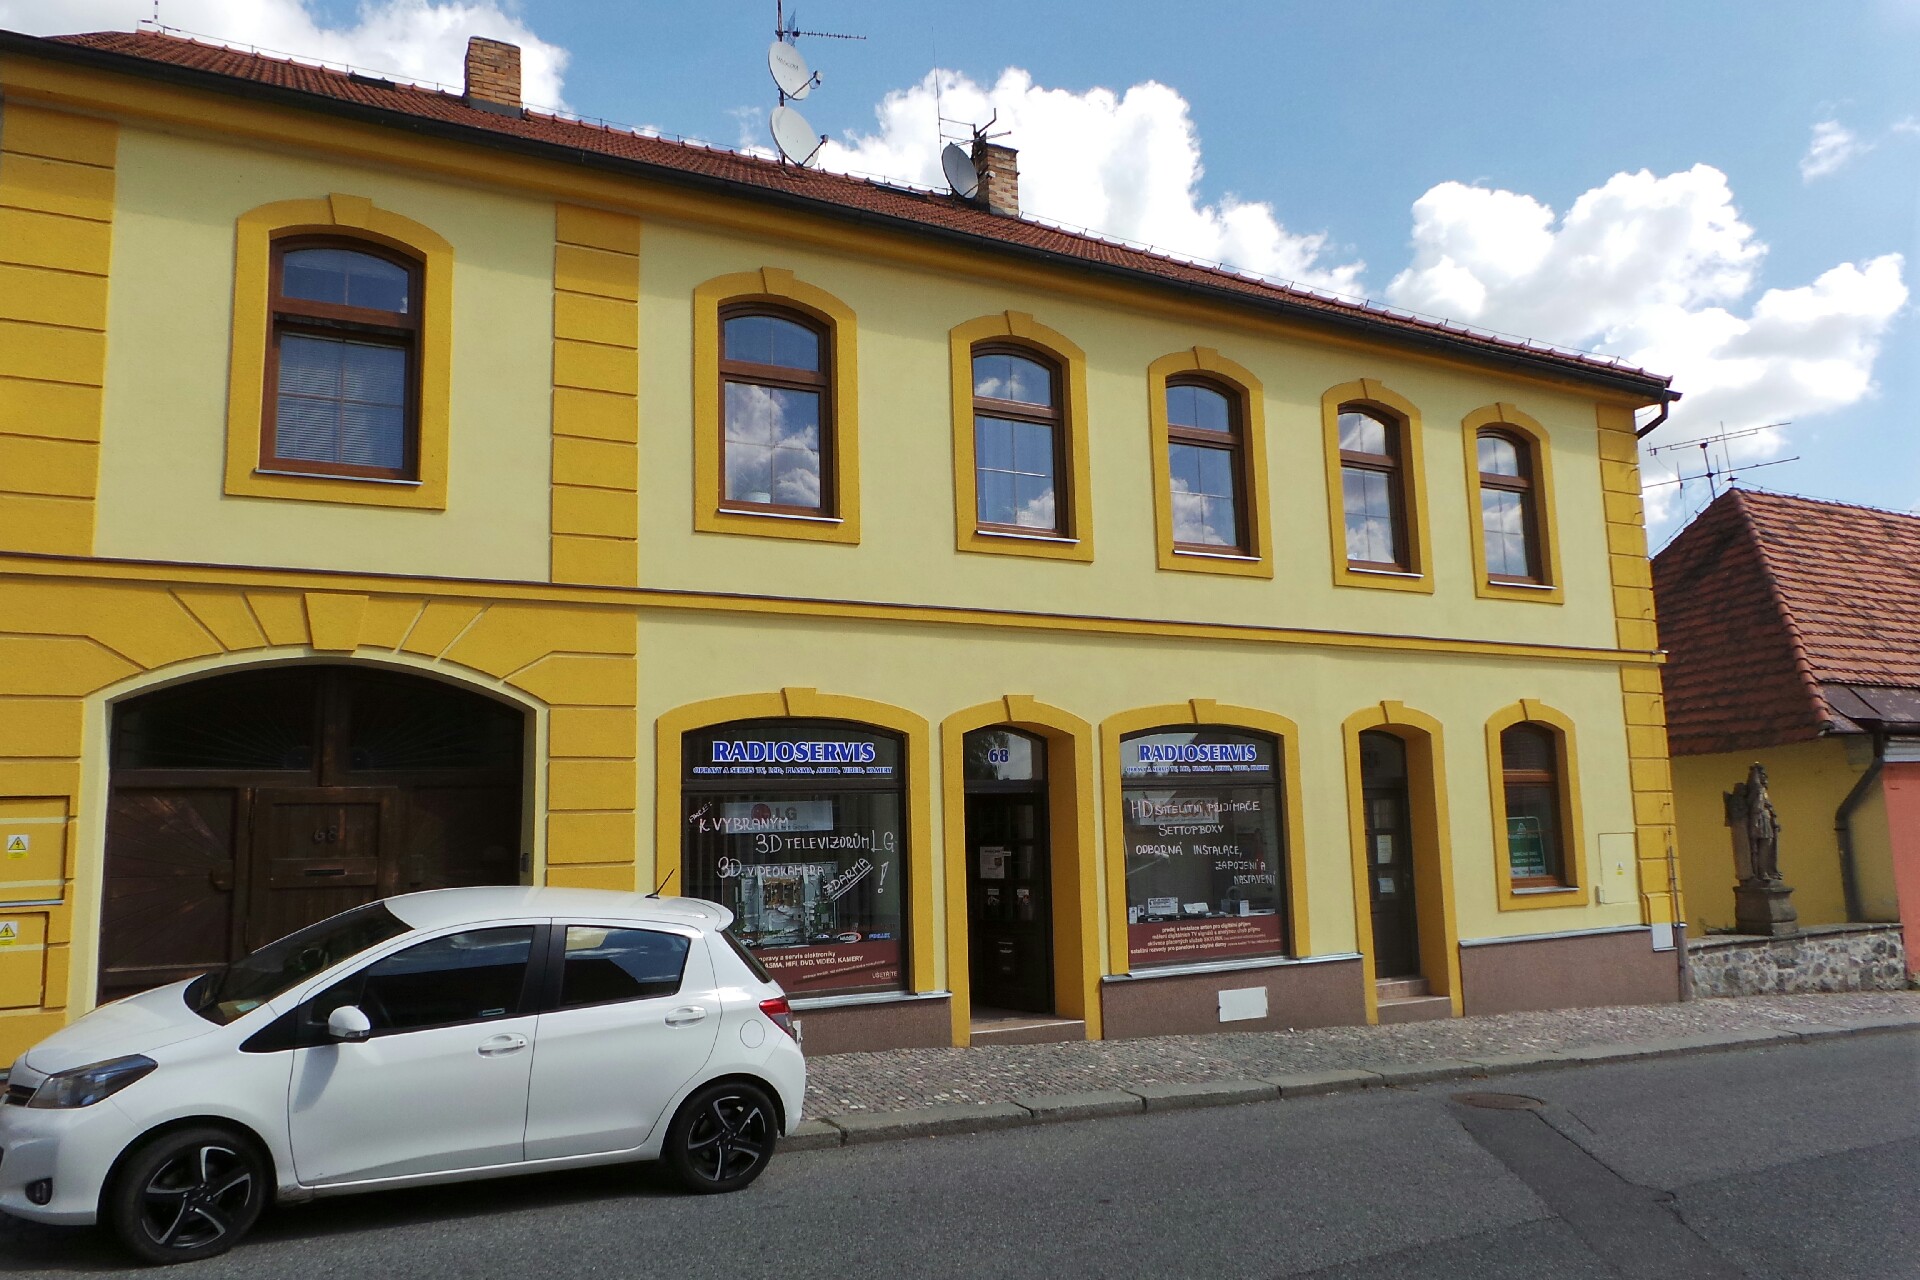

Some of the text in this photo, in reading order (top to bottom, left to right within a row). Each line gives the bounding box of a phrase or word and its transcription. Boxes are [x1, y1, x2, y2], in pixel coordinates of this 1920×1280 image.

[712, 741, 876, 763] RADIOSERVIS
[987, 748, 1010, 764] 68
[1139, 744, 1257, 762] RADIOSERVIS
[1131, 799, 1153, 818] HD
[699, 818, 710, 833] K
[713, 815, 789, 834] VYBRANÝM
[755, 830, 894, 853] 3D TELEVIZORŮM LG
[1135, 842, 1183, 856] ODBORNÁ
[716, 856, 825, 878] 3D VIDEOKAMERA
[1215, 859, 1259, 870] ZAPOJENÍ
[823, 858, 871, 893] ZDARMA
[765, 961, 785, 969] ASMA,
[816, 957, 837, 965] VIDEO,
[838, 955, 864, 963] KAMERY
[785, 952, 803, 960] servis
